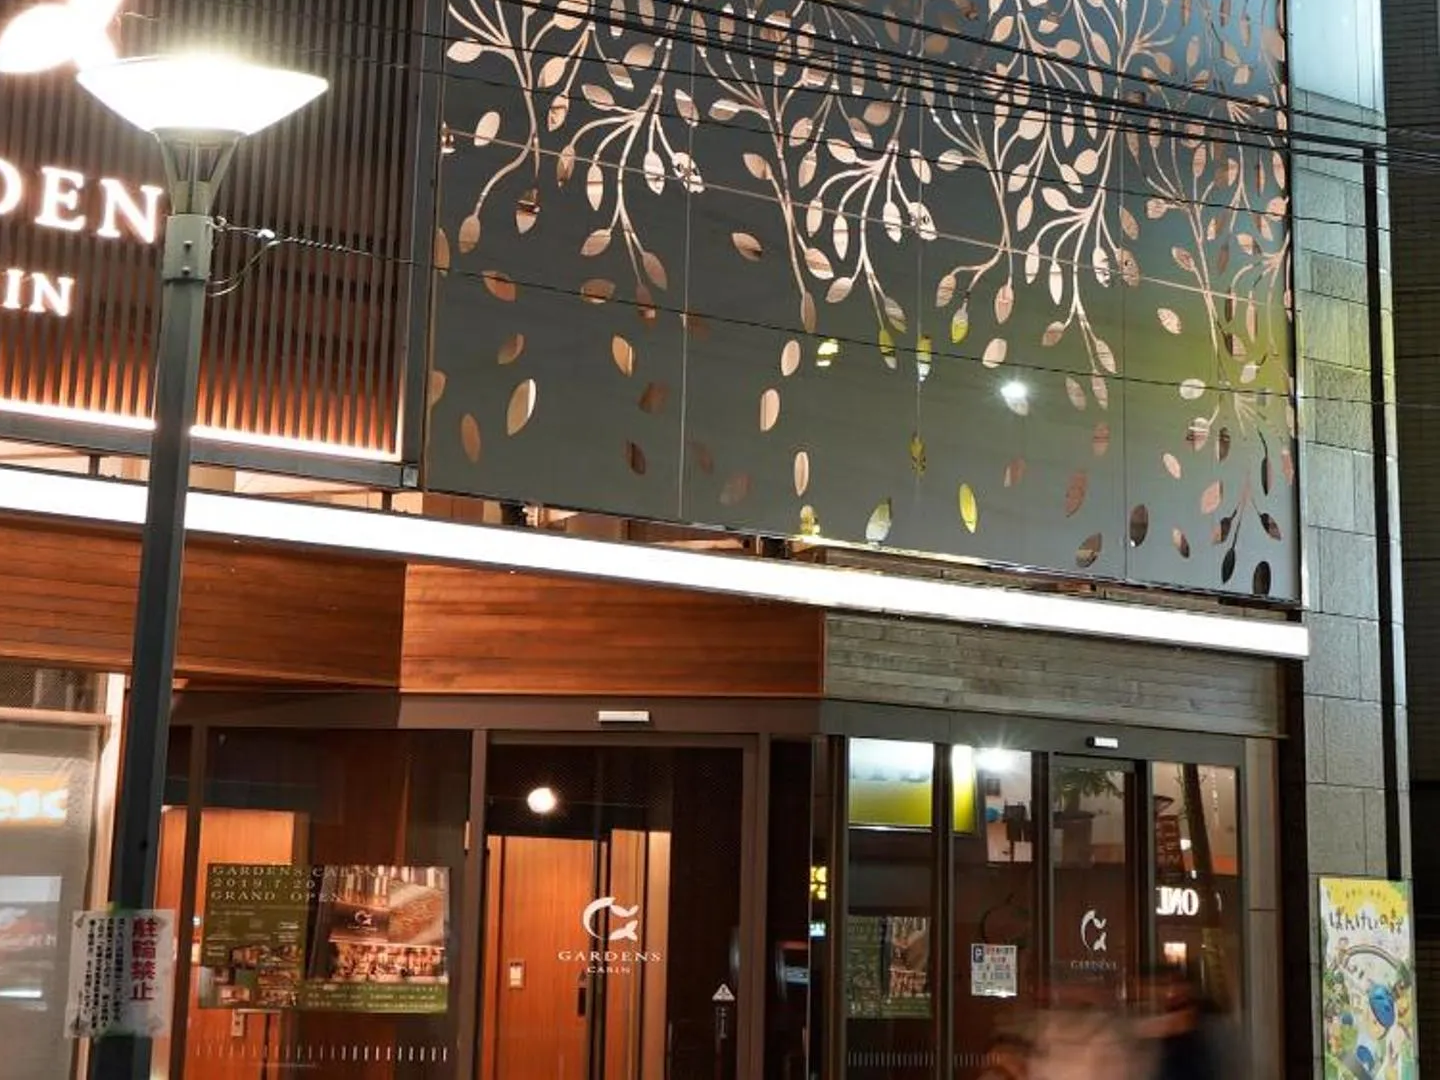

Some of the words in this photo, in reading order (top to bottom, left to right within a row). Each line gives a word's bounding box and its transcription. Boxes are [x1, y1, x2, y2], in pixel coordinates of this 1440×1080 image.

[212, 866, 303, 877] GARDENS
[210, 891, 276, 901] GRAND
[129, 918, 159, 1001] 駐輪禁止
[557, 950, 662, 962] GARDENS
[586, 965, 631, 974] CABIN
